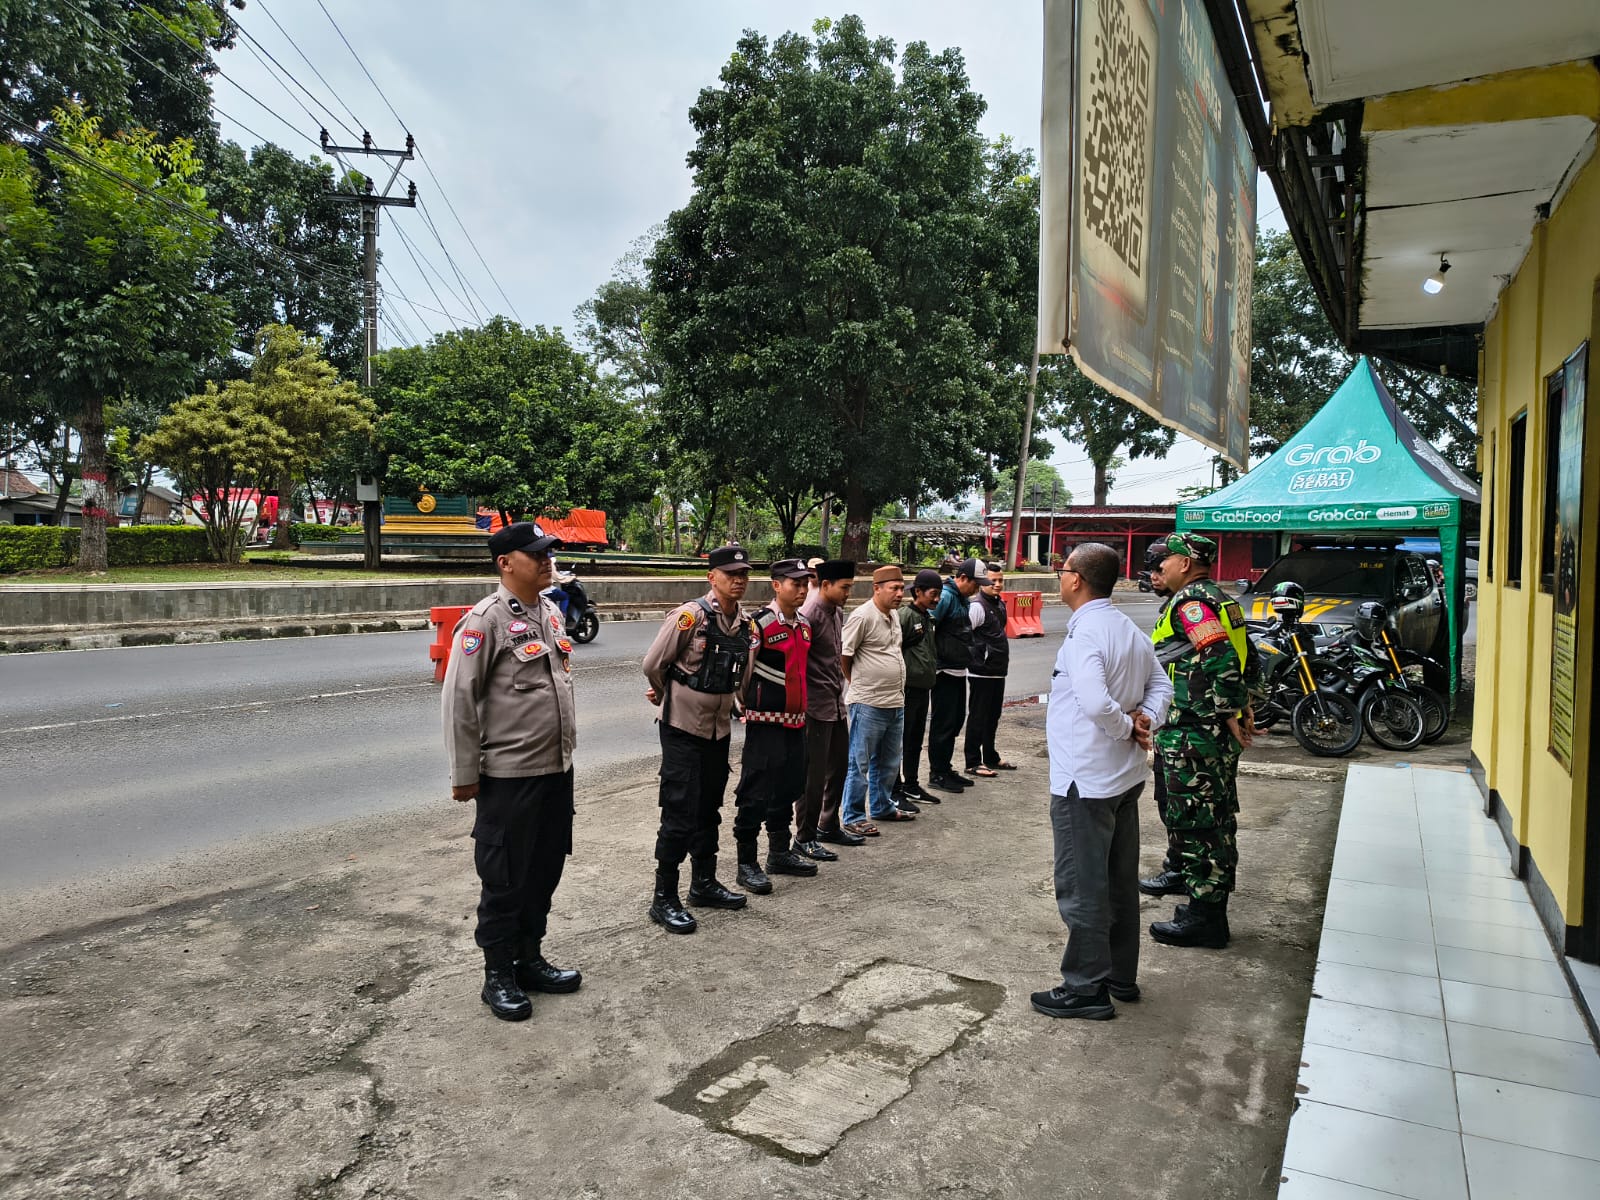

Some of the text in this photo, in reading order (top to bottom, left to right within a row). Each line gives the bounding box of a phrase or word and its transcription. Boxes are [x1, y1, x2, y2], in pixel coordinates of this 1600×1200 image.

[1287, 440, 1381, 466] Grab
[1293, 479, 1347, 490] HEMAT
[1211, 510, 1282, 523] GrabFood
[1307, 508, 1410, 522] GrabCar Hemat
